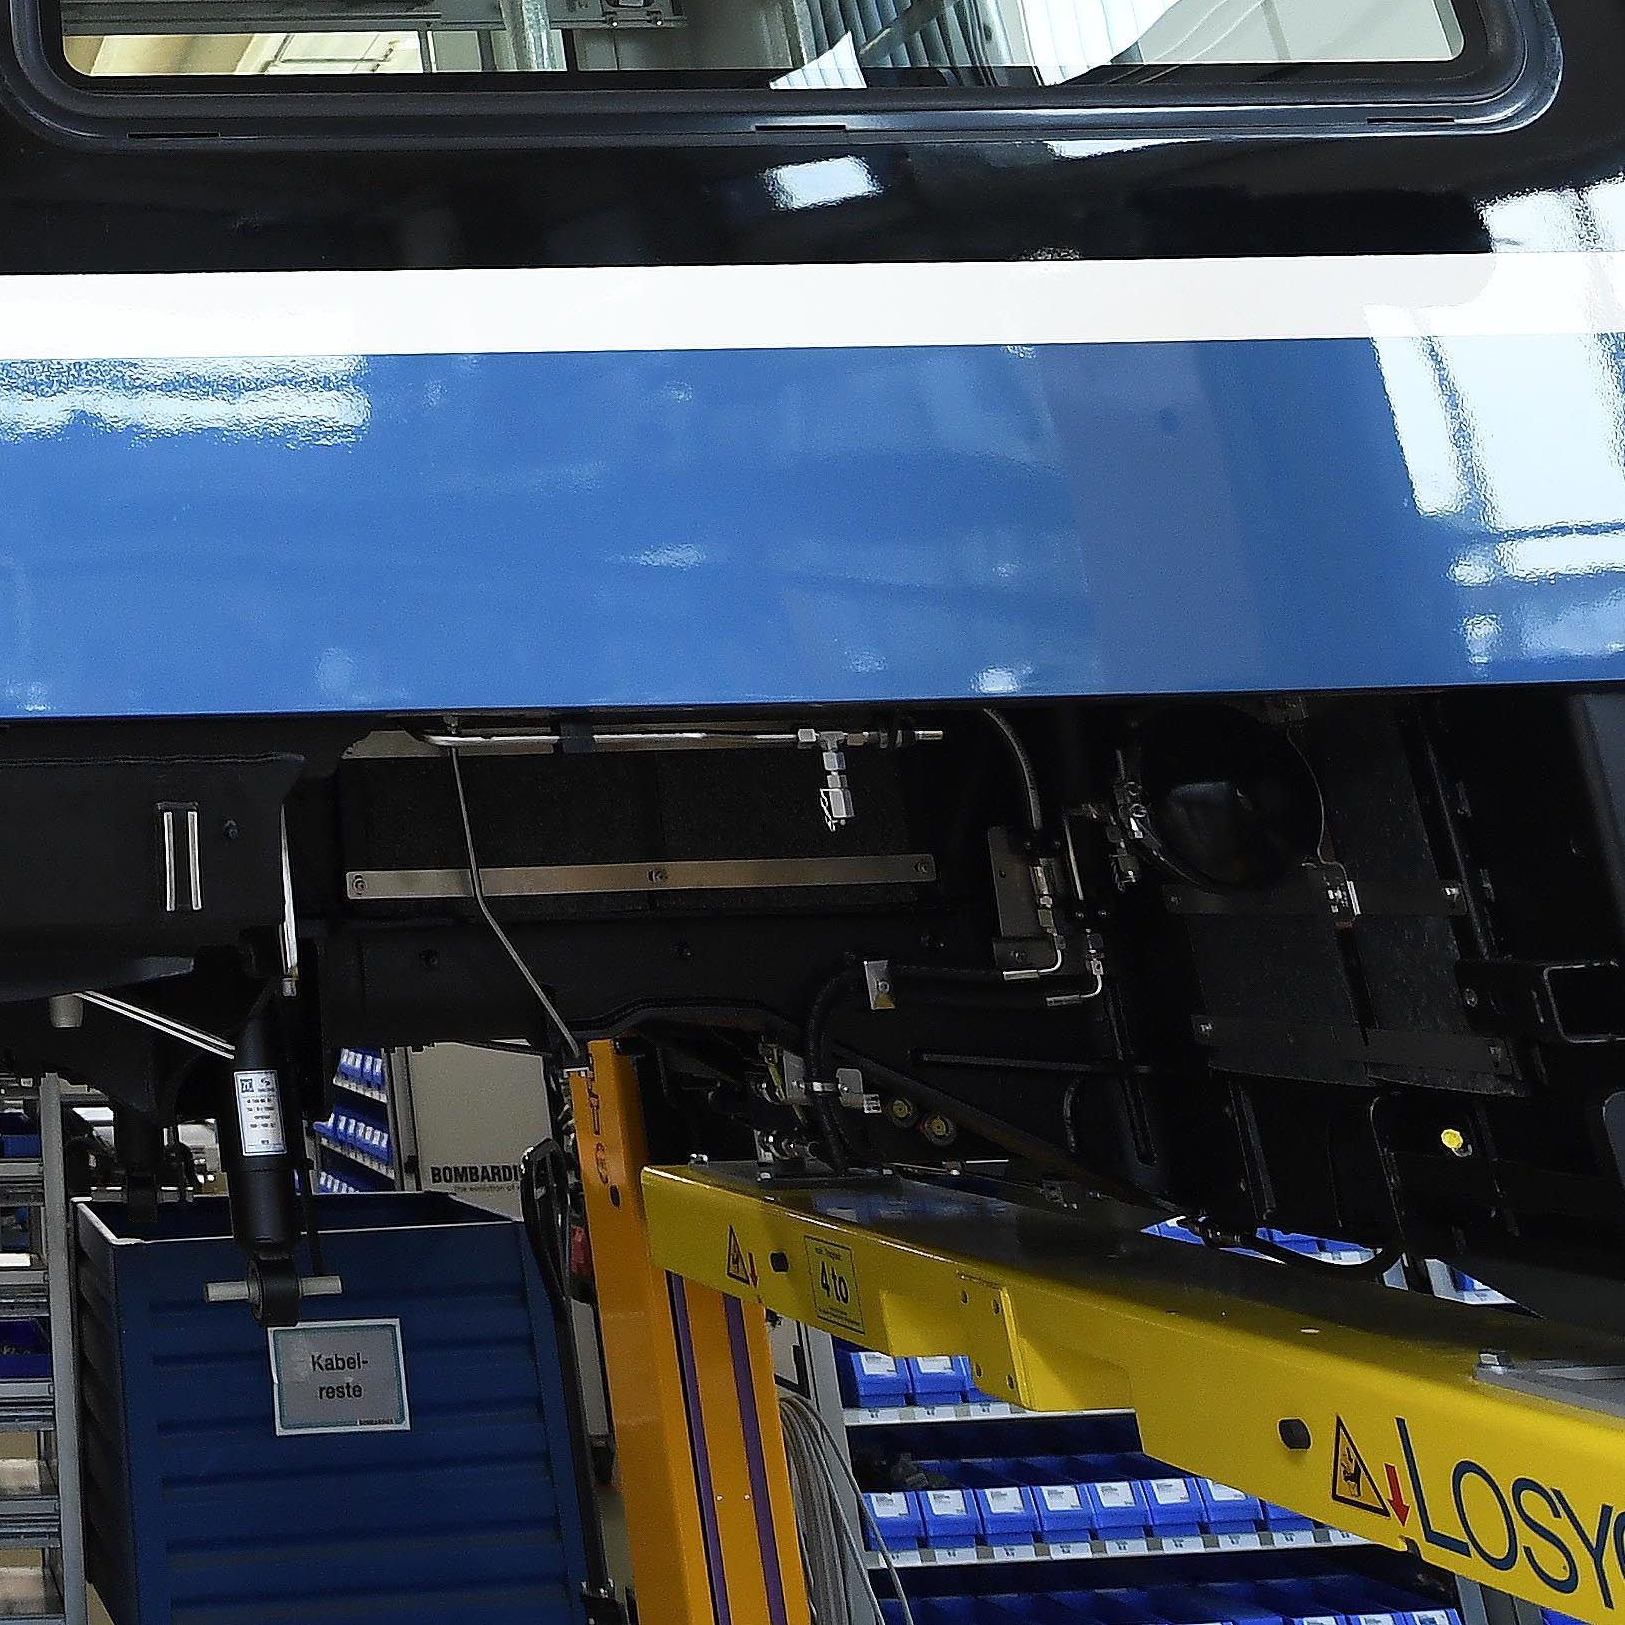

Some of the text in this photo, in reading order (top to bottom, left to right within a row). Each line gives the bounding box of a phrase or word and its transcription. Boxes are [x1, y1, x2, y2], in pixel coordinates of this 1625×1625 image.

[820, 1261, 850, 1305] 4 to
[311, 1352, 369, 1372] Kabel-
[318, 1382, 363, 1400] reste
